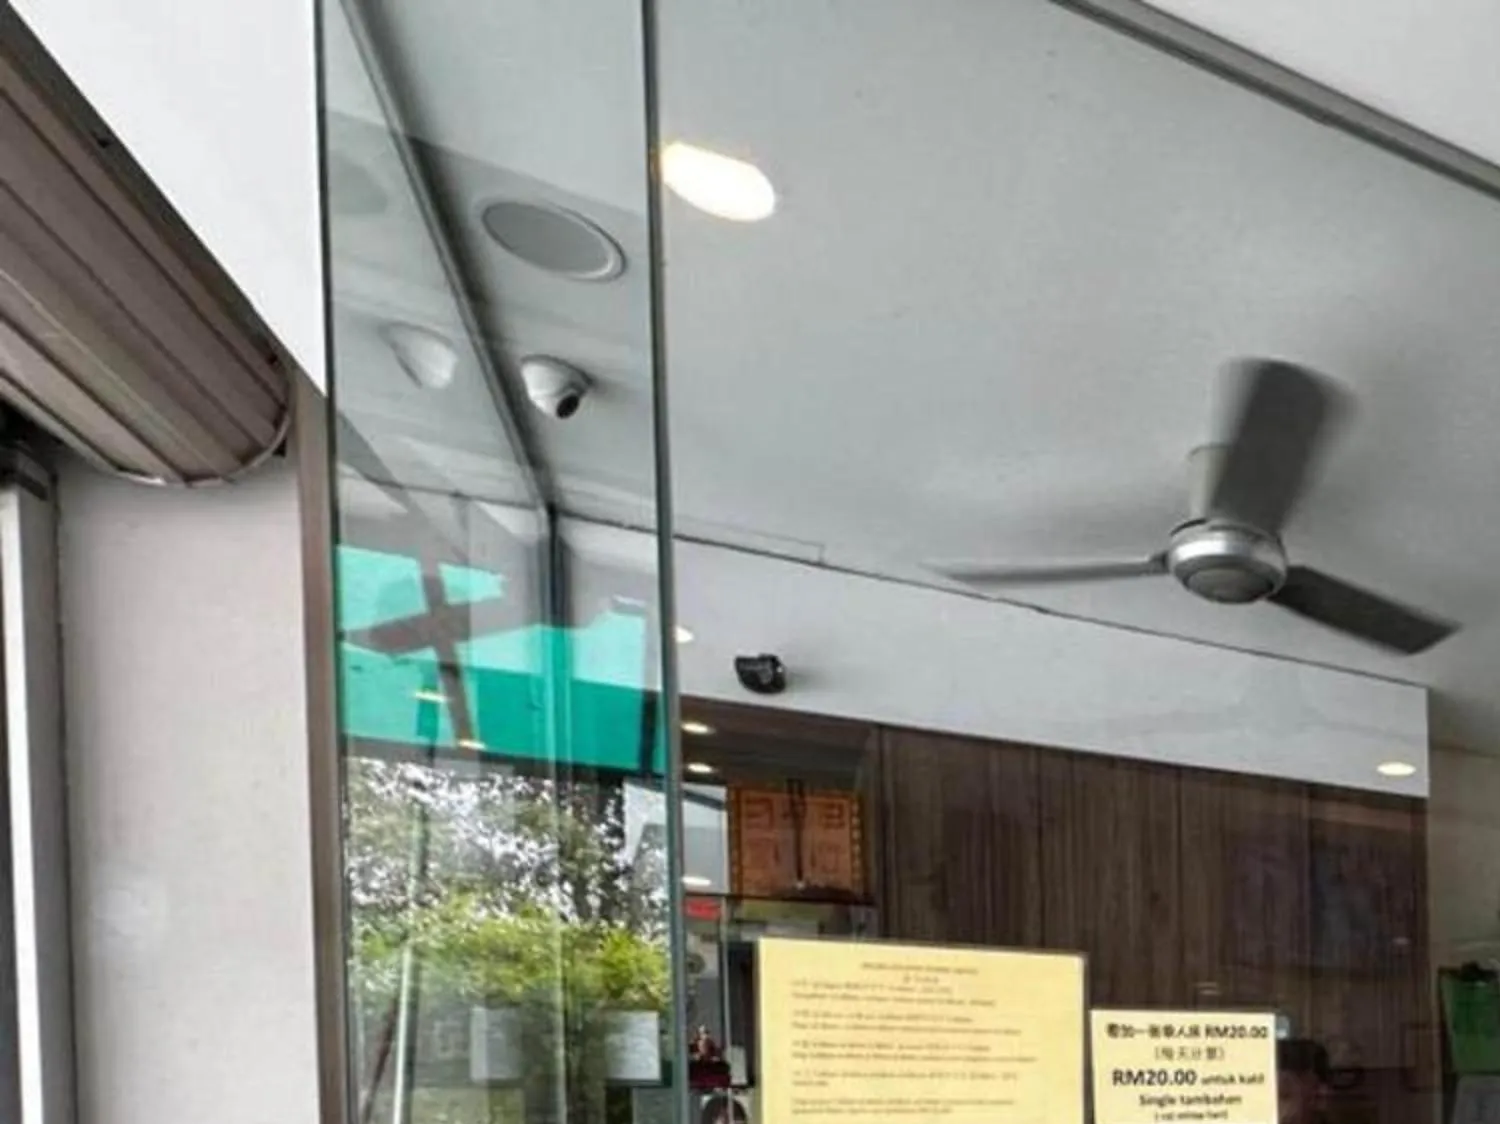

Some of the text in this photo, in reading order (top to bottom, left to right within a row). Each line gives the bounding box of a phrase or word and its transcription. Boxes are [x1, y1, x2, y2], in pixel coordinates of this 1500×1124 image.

[1204, 1024, 1269, 1040] RM20.00
[1112, 1068, 1198, 1086] RM20.00
[1139, 1094, 1176, 1108] Single
